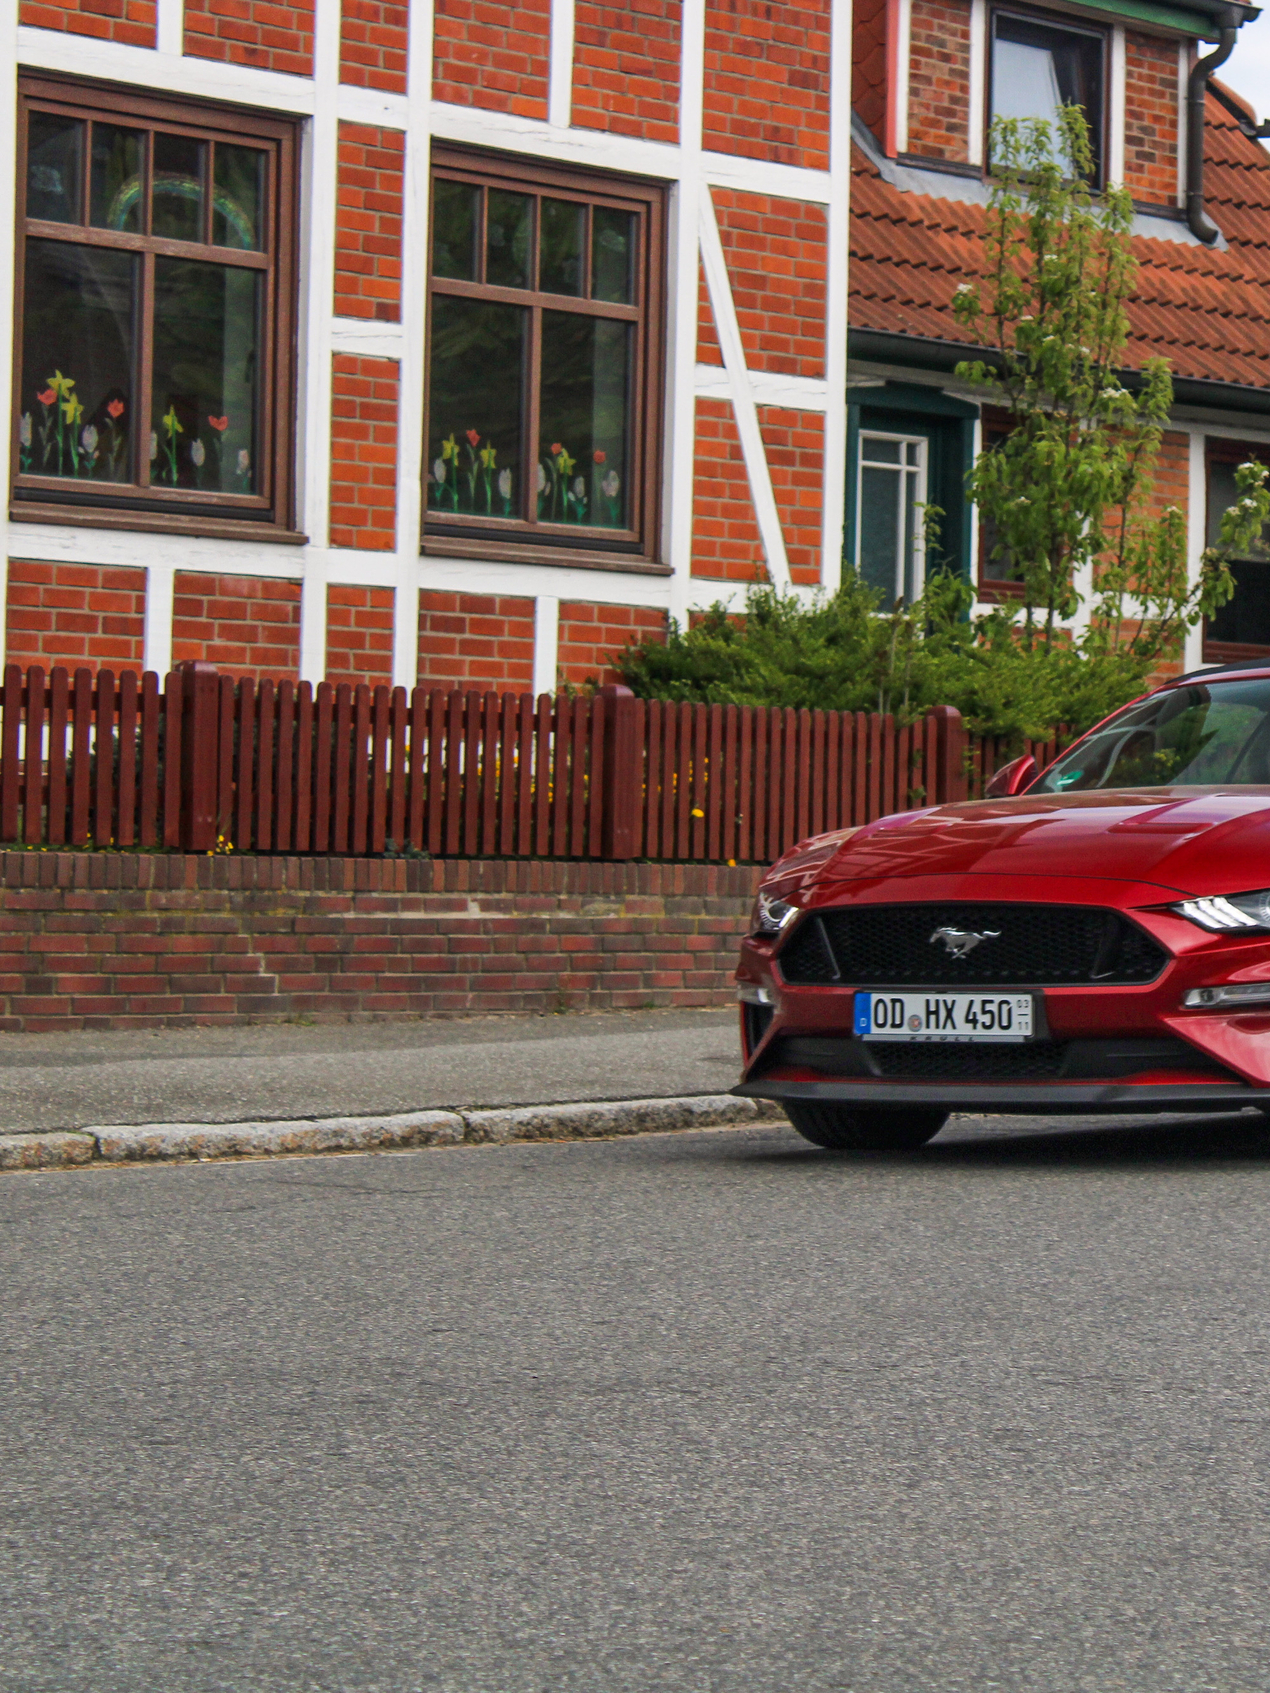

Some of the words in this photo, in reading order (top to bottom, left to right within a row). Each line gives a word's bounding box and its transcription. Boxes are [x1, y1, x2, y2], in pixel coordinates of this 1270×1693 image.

[874, 998, 905, 1029] OD
[925, 998, 957, 1030] HX
[964, 999, 1012, 1031] 450
